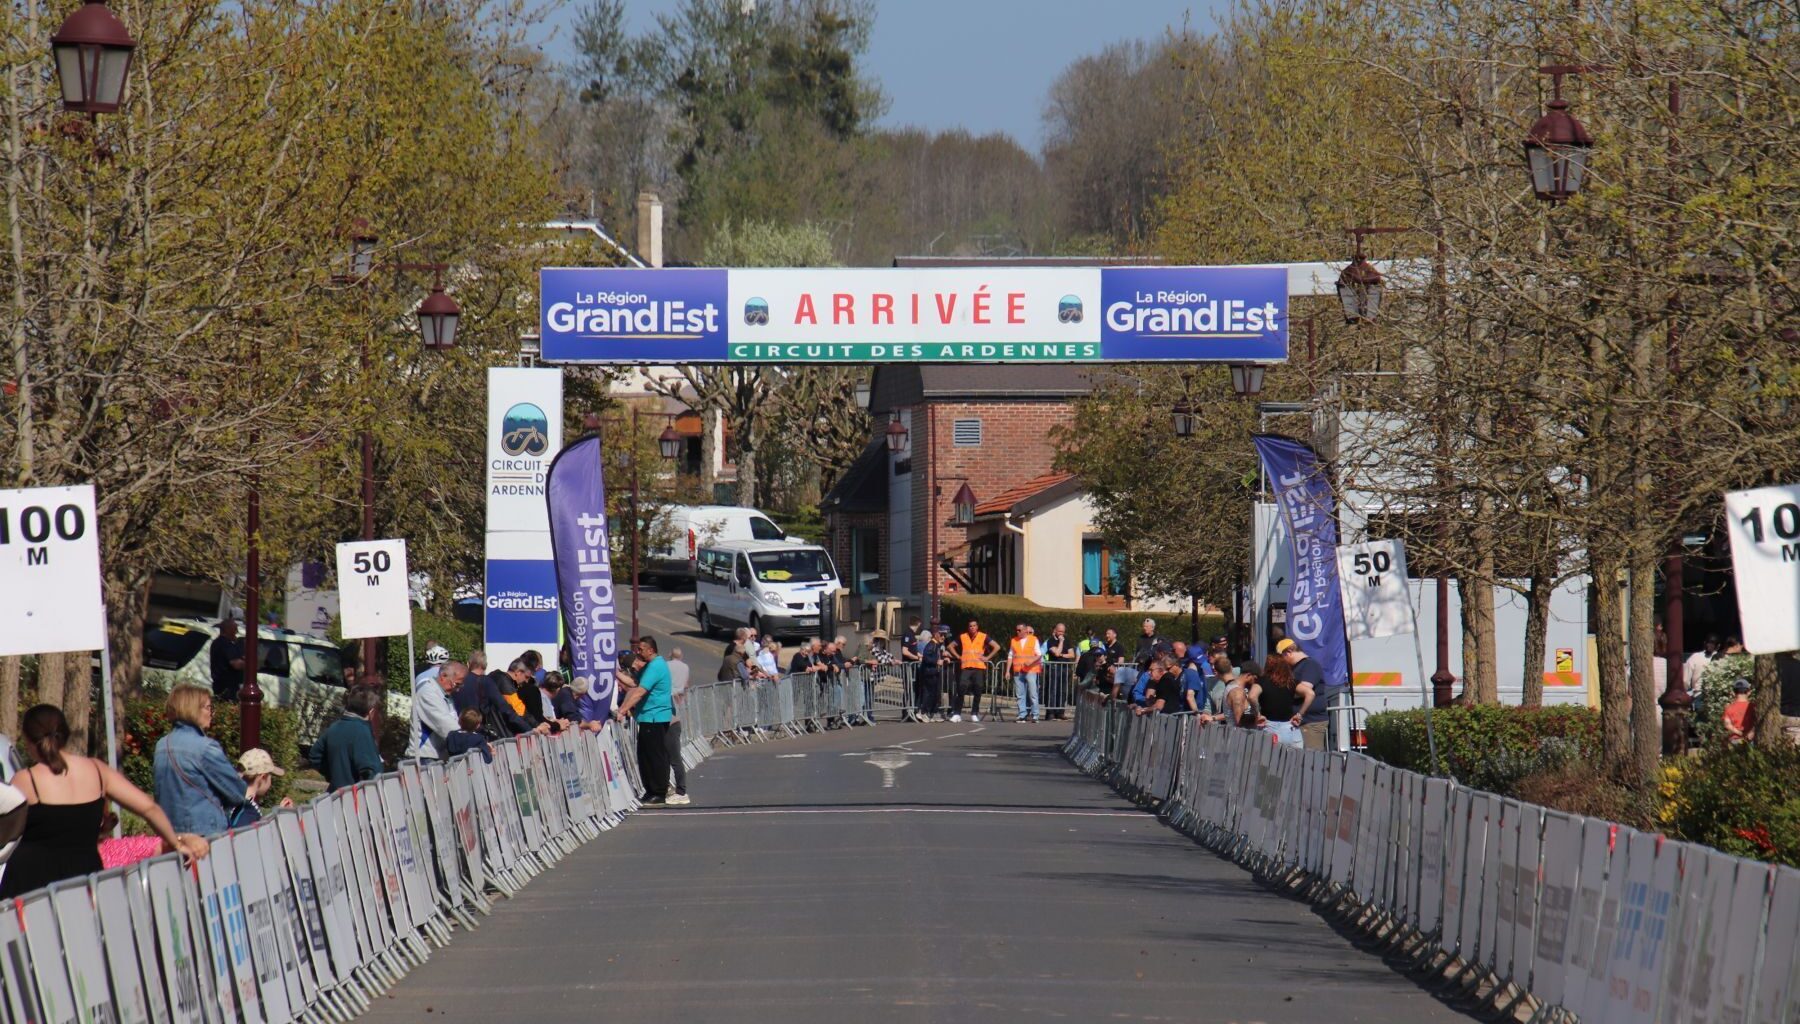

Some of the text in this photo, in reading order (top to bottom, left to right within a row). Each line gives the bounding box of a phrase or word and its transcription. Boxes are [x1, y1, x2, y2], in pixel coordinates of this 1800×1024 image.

[576, 290, 648, 306] La Région
[794, 285, 1026, 325] ARRIVÉE
[1136, 289, 1207, 306] La Région
[734, 344, 1096, 358] CIRCUIT DES ARDENNES
[491, 459, 542, 471] CIRCUIT
[535, 472, 548, 484] D
[491, 484, 544, 496] ARDENN
[0, 503, 85, 544] 100
[27, 546, 49, 566] M
[353, 550, 391, 574] 50
[1782, 544, 1800, 563] M
[1354, 551, 1391, 575] 50
[367, 575, 380, 587] M
[1368, 576, 1381, 587] M
[573, 591, 588, 671] La Région
